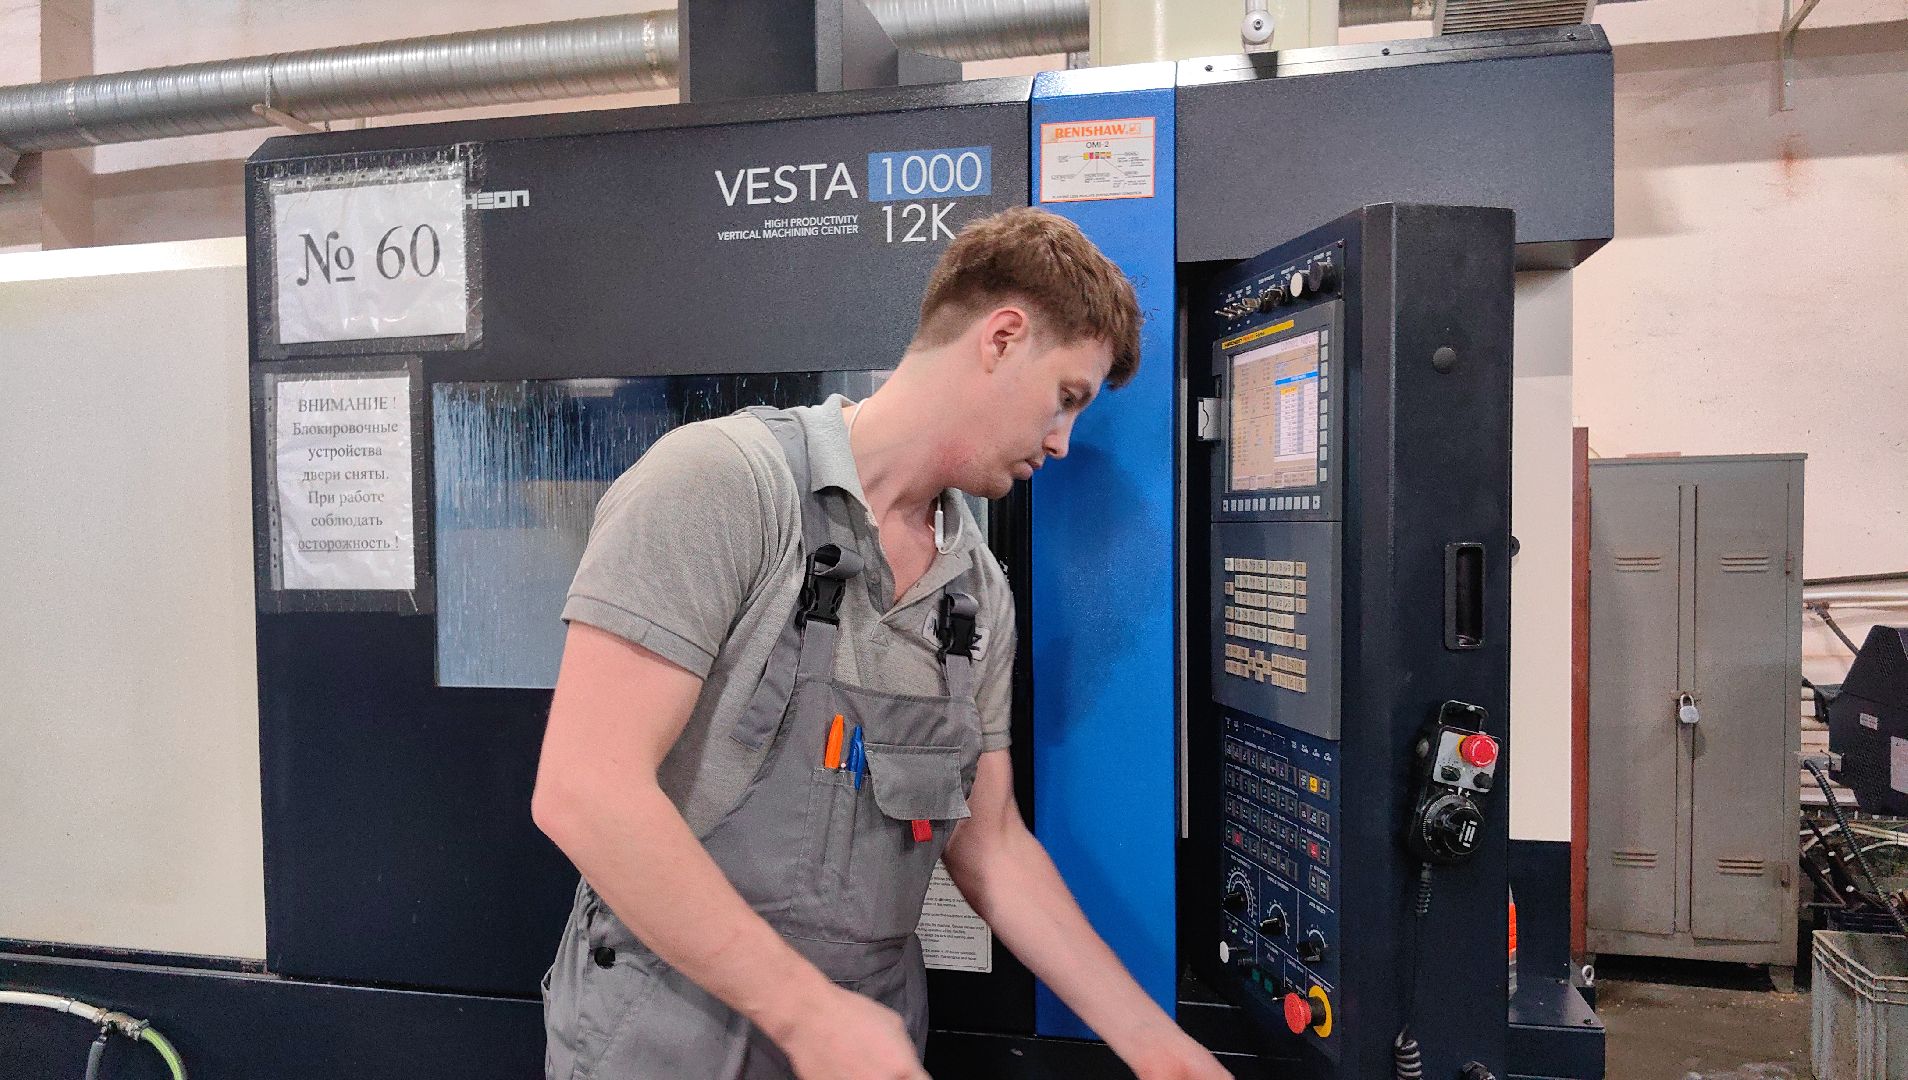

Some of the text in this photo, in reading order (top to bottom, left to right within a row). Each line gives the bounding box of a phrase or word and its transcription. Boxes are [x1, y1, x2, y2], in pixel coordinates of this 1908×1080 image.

[1055, 124, 1126, 139] RENISHAW
[715, 151, 983, 207] VESTA 1000
[764, 214, 859, 229] HIGH PRODUCTIVITY
[881, 202, 957, 244] 12K
[717, 224, 859, 241] VERTICAL MACHINING CENTER
[376, 223, 441, 280] 60
[292, 422, 399, 438] Блокировочные
[308, 444, 383, 461] устройства
[302, 470, 390, 484] двери сняты.
[308, 489, 385, 507] При работе
[311, 513, 384, 527] соблюдать
[298, 539, 391, 552] осторожность
